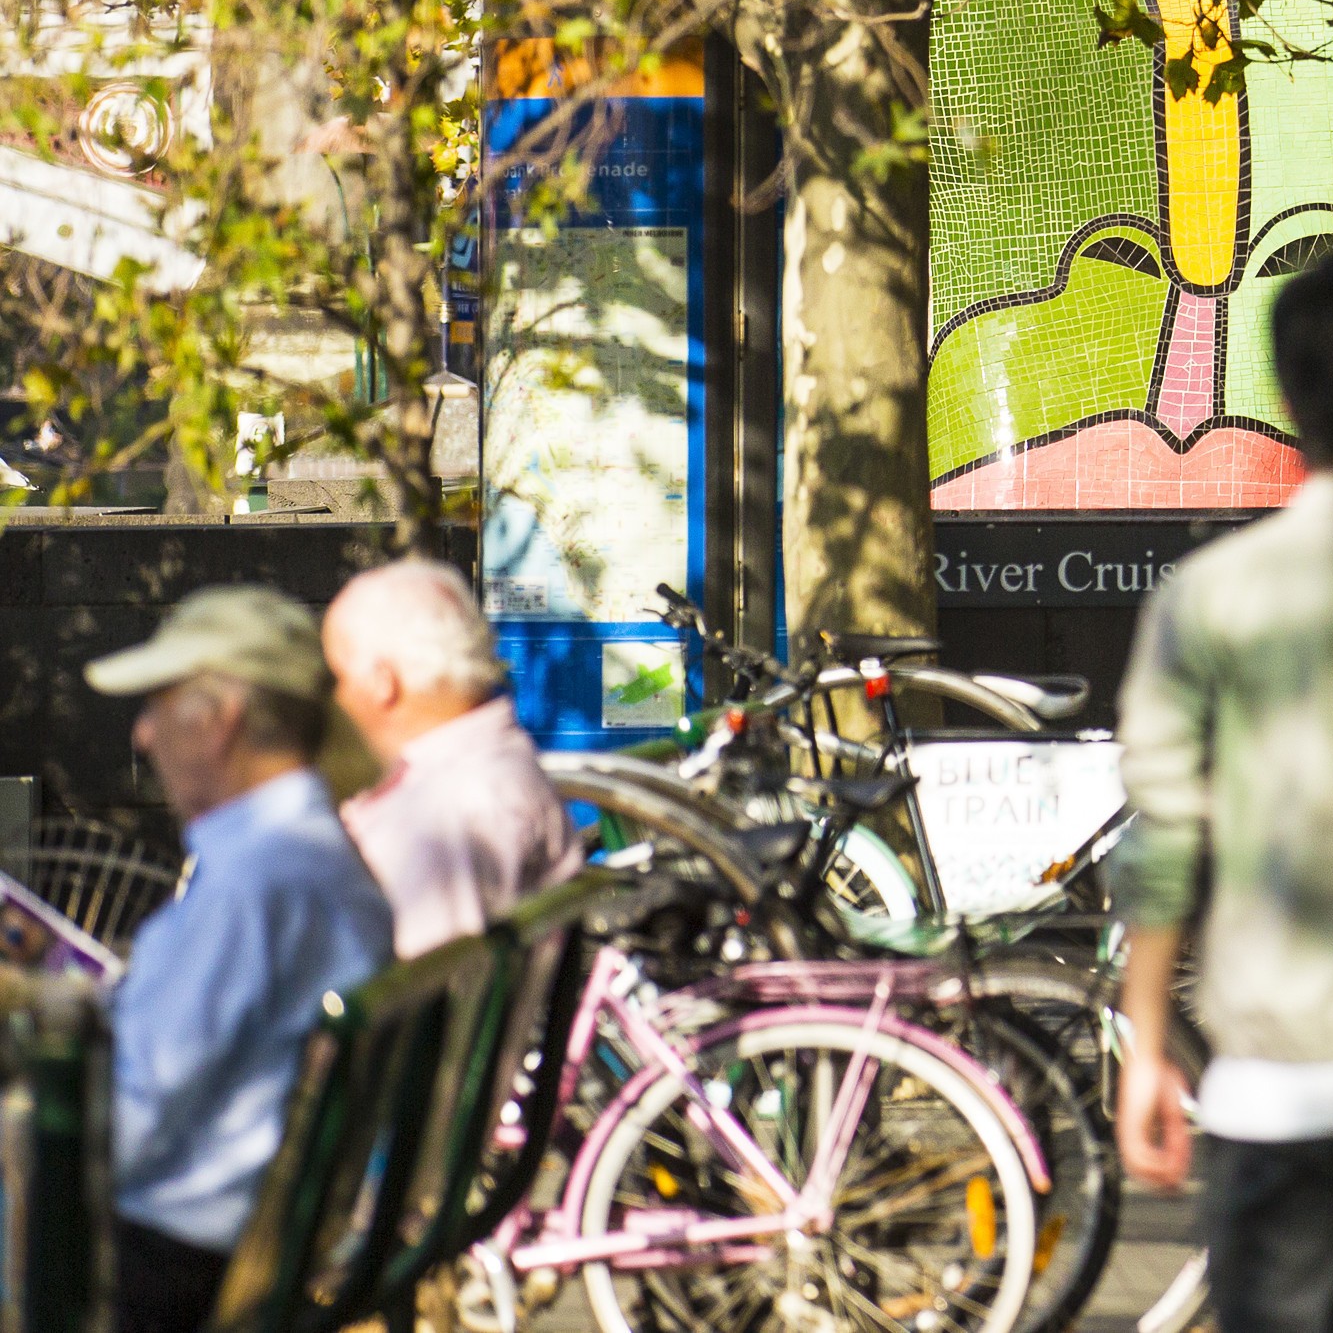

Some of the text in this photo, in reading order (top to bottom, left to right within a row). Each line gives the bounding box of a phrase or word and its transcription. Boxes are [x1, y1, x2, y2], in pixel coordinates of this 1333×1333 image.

[933, 550, 1043, 592] River
[937, 755, 1034, 786] BLUE
[942, 794, 1060, 825] TRAIN
